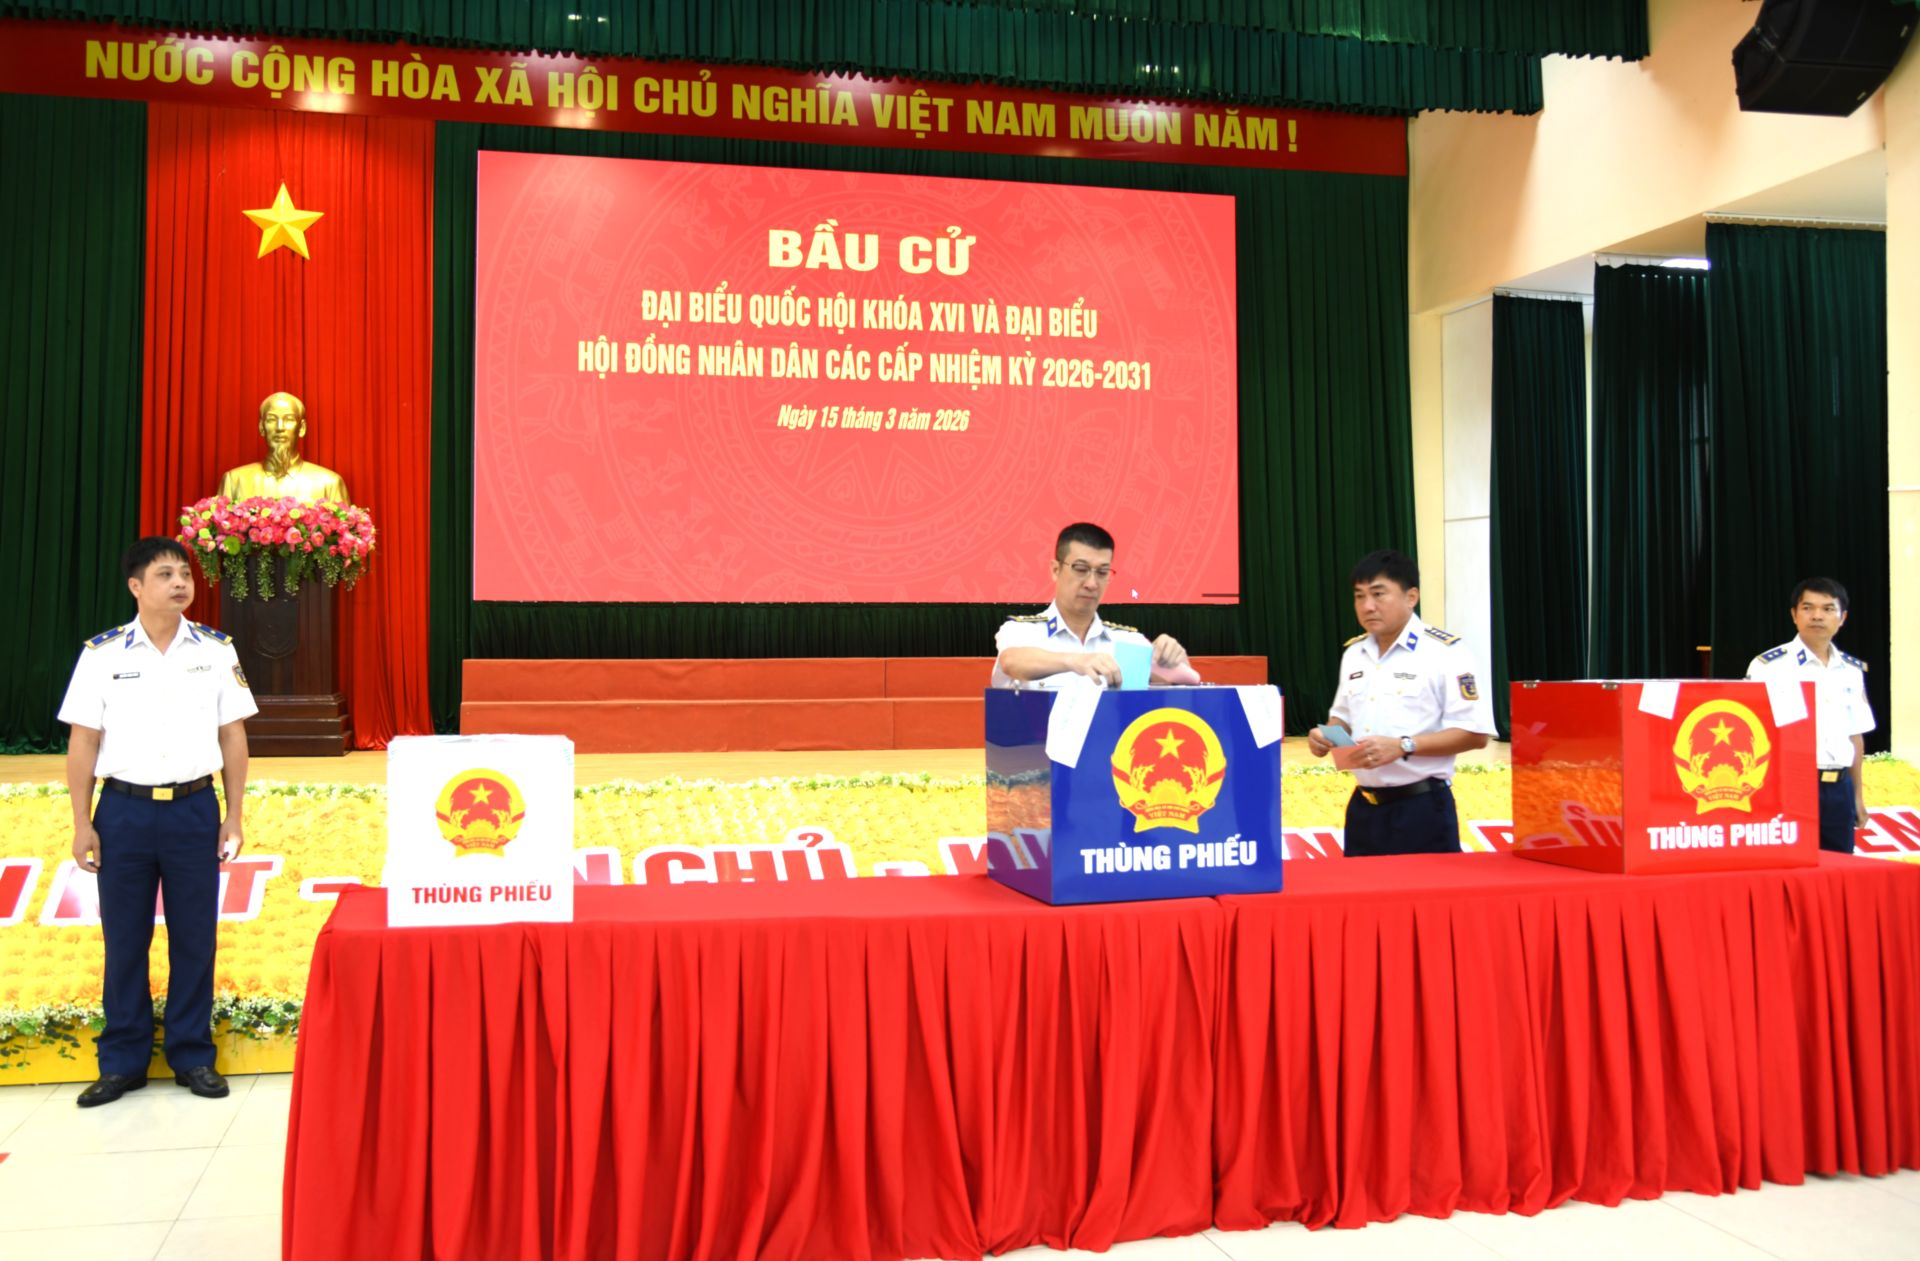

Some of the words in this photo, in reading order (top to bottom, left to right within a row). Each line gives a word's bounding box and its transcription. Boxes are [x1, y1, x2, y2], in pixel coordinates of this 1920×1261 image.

[85, 35, 214, 84] NƯỚC
[230, 44, 356, 99] CỘNG
[371, 53, 461, 102] HÒA
[474, 61, 534, 106] XÃ
[547, 66, 618, 118] HỘI
[633, 70, 718, 118] CHỦ
[732, 83, 859, 127] NGHĨA
[870, 88, 954, 139] VIỆT
[966, 99, 1056, 138] NAM
[1069, 104, 1182, 145] MUÔN
[1194, 108, 1279, 152] NĂM
[768, 218, 880, 272] BẦU
[898, 225, 977, 277] CỬ
[641, 289, 683, 329] ĐẠI
[688, 280, 743, 325] BIỂU
[748, 284, 811, 330] QUỐC
[817, 291, 857, 335] HỘI
[862, 293, 924, 333] KHÓA
[928, 301, 966, 334] XVI
[970, 297, 1001, 335] VÀ
[1004, 304, 1043, 343] ĐẠI
[1048, 296, 1099, 340] BIỂU
[577, 334, 619, 380] HỘI
[624, 332, 691, 376] ĐỒNG
[697, 339, 764, 379] NHÂN
[770, 341, 819, 381] DÂN
[825, 343, 872, 382] CÁC
[877, 341, 924, 384] CẤP
[929, 347, 1003, 392] NHIỆM
[1008, 350, 1037, 387] KỲ
[1041, 356, 1152, 391] 2026-2031
[776, 403, 818, 431] Ngày
[820, 405, 841, 429] 15
[840, 405, 884, 434] tháng
[885, 407, 898, 431] 3
[898, 407, 932, 431] năm
[931, 408, 971, 432] 2026
[1080, 841, 1171, 874] THÙNG
[1178, 833, 1257, 869] PHIẾU
[1647, 821, 1725, 850] THÙNG
[1730, 813, 1798, 847] PHIẾU
[411, 882, 483, 905] THÙNG
[489, 879, 552, 903] PHIẾU
